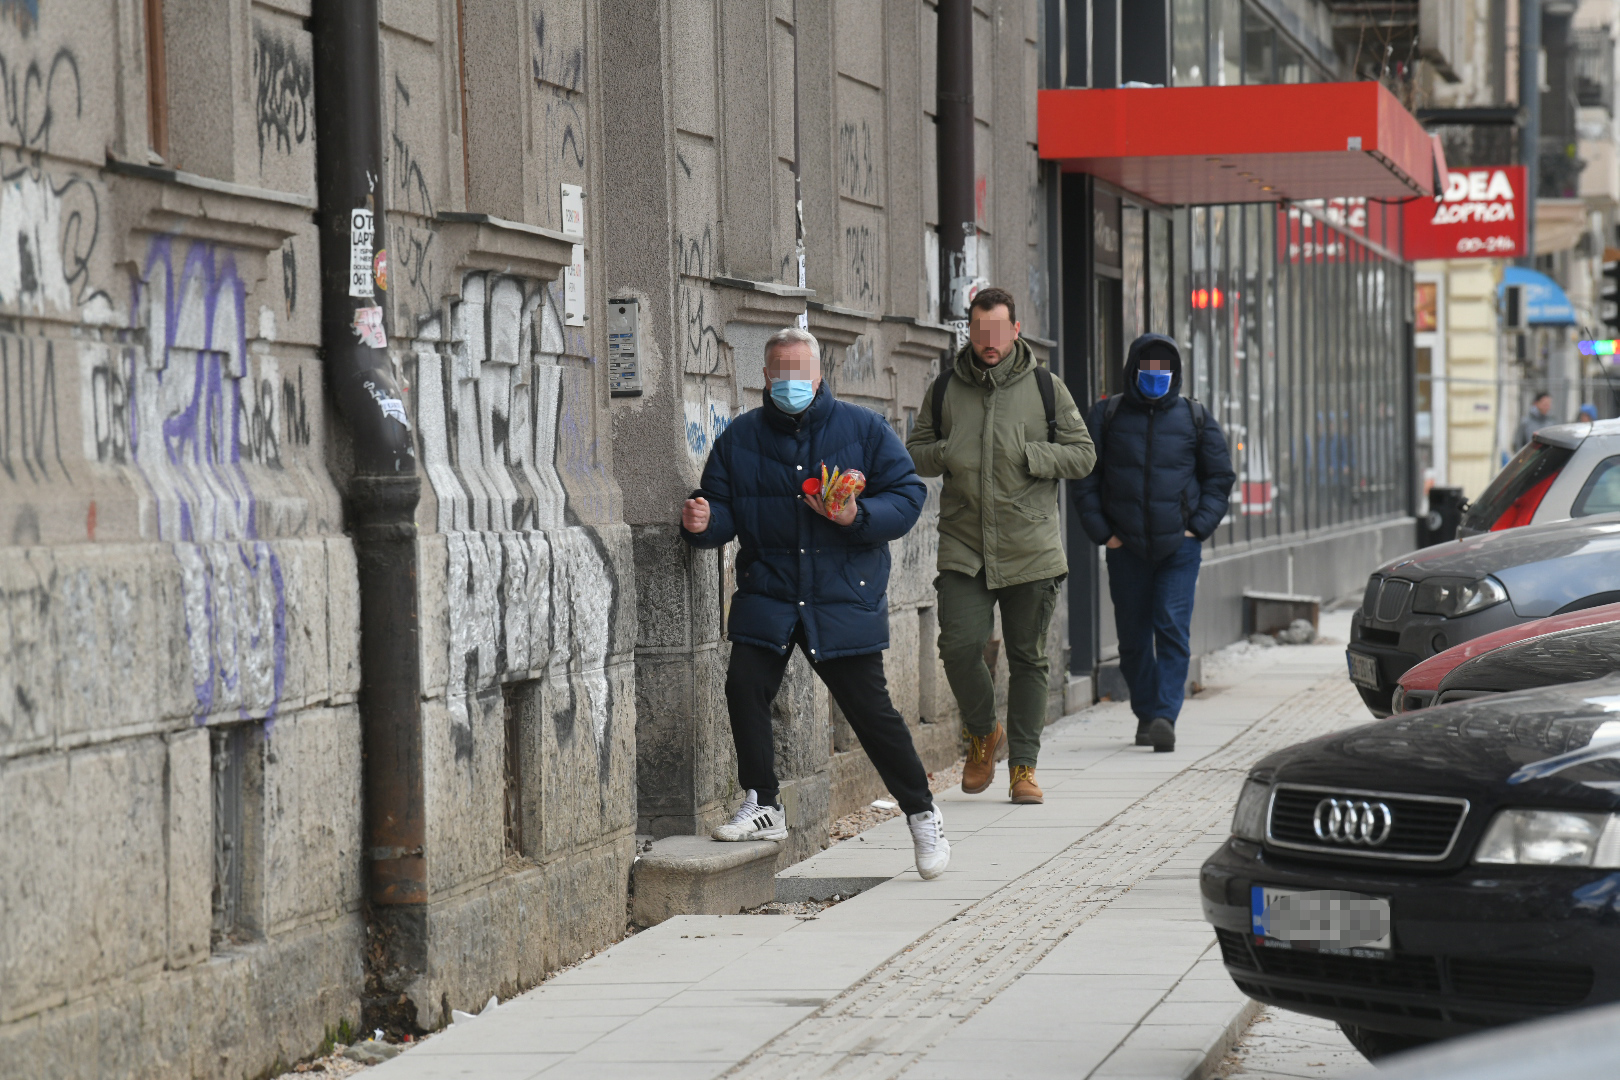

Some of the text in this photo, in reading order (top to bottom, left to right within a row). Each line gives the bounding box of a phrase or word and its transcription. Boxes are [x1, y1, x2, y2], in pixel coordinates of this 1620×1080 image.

[1434, 170, 1514, 202] DEA
[353, 214, 374, 230] OT
[352, 231, 374, 246] LAPT
